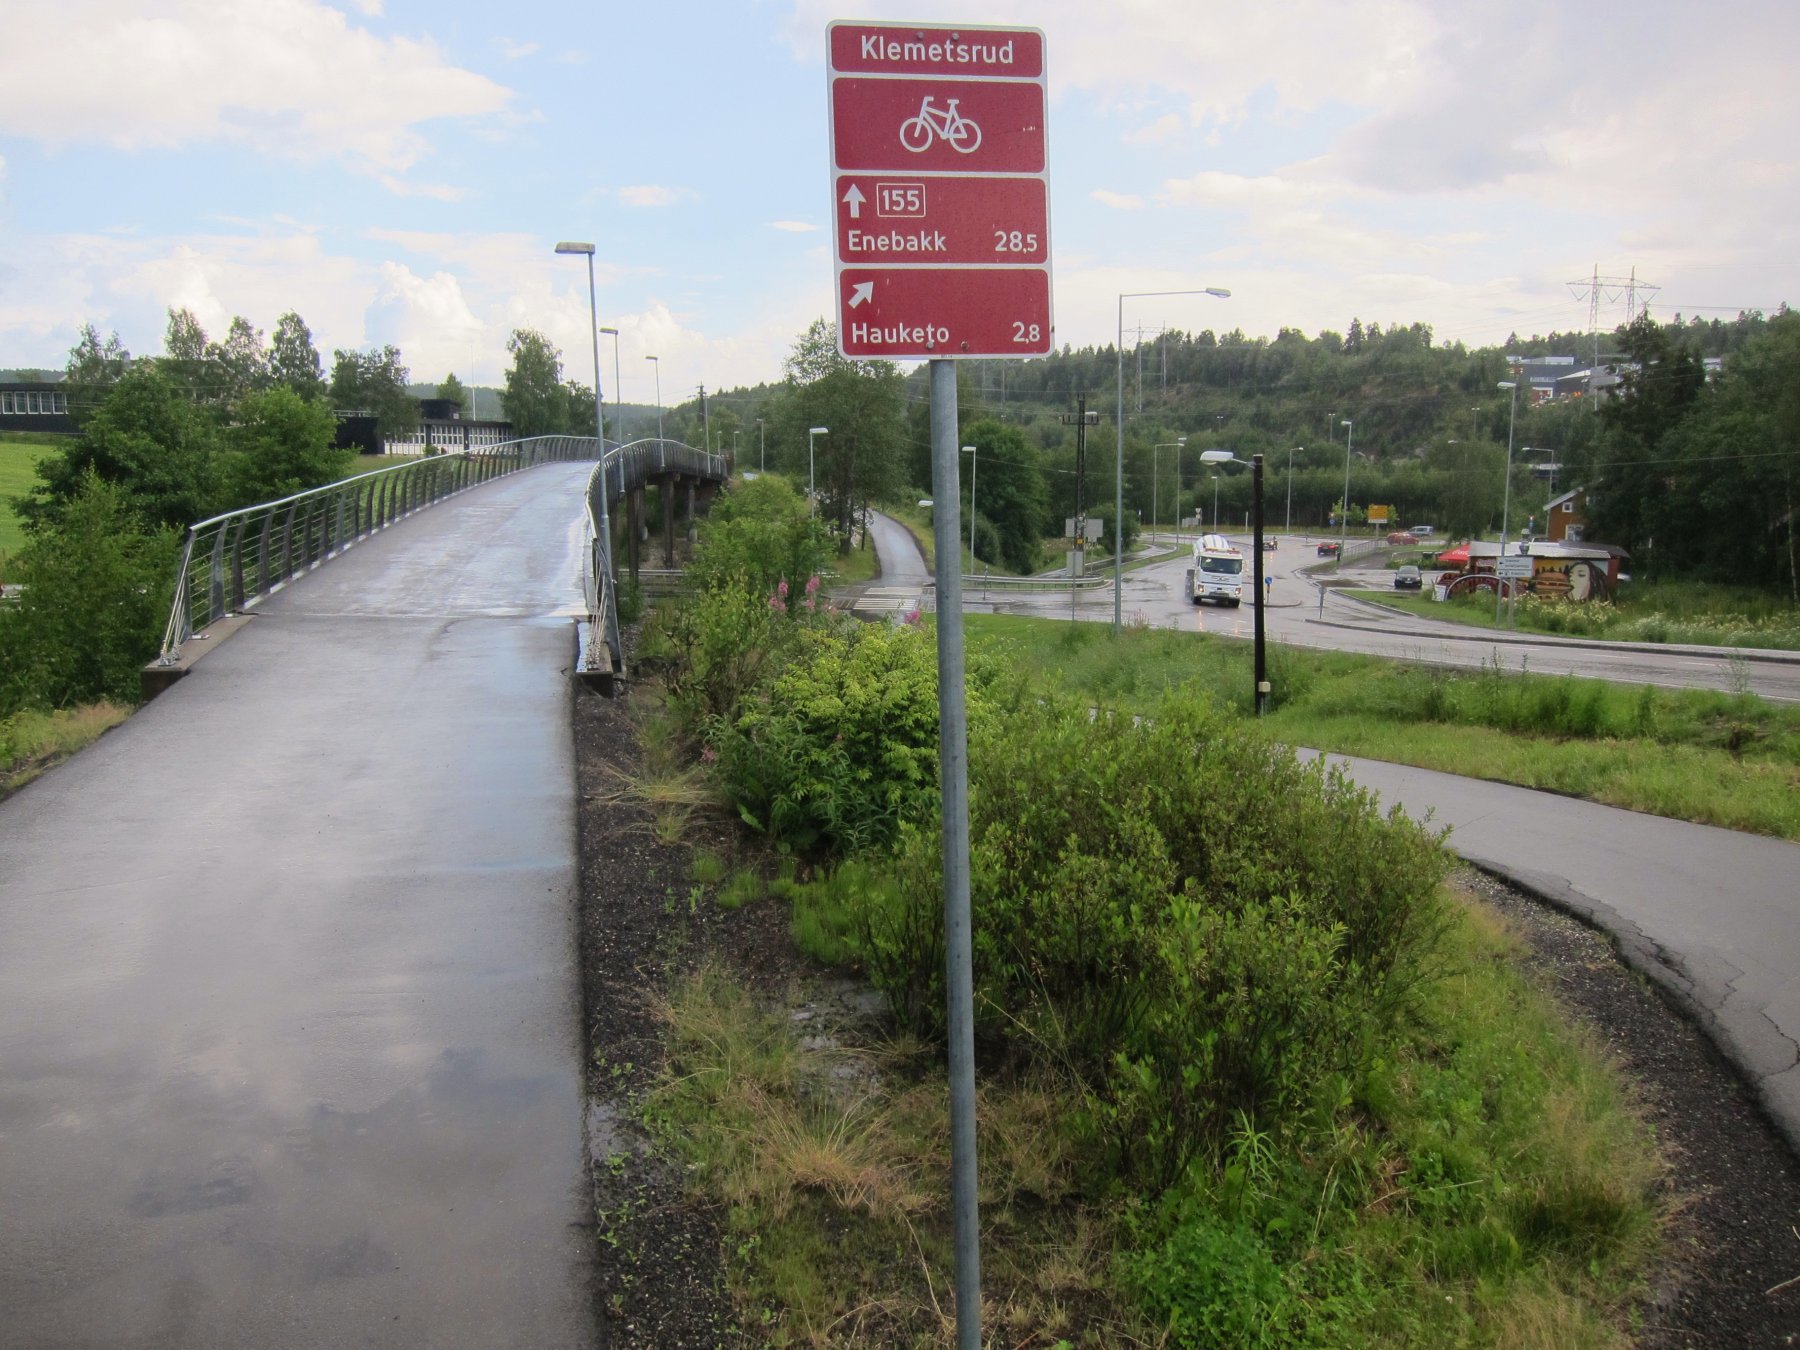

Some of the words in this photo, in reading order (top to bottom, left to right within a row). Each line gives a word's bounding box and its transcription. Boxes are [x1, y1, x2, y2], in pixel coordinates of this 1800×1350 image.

[861, 35, 1014, 64] Klemetsrud
[882, 189, 920, 212] 155
[848, 230, 947, 252] Enebakk
[994, 230, 1038, 255] 28,5
[851, 322, 950, 345] Hauketo
[1012, 321, 1041, 344] 2,8
